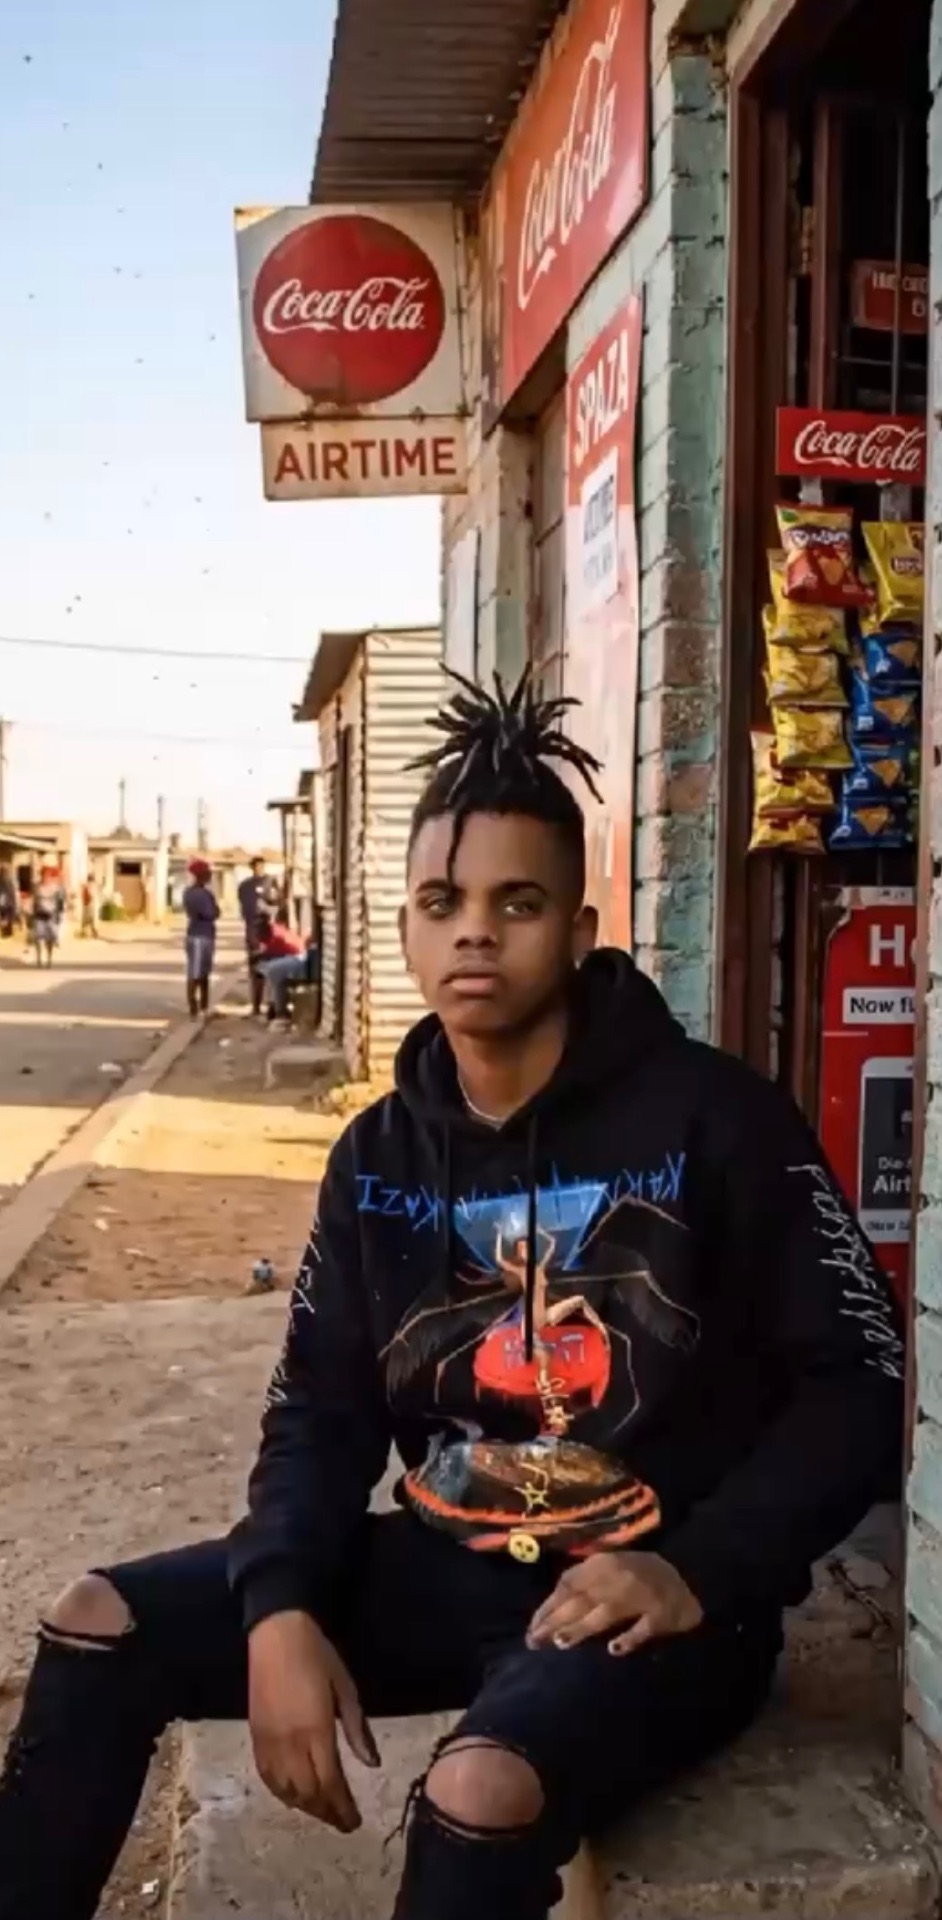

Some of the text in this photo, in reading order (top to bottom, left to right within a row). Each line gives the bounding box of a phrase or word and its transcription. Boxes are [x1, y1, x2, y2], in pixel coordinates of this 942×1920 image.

[262, 276, 431, 334] Coca-Cola
[574, 328, 629, 468] SPAZA
[274, 437, 457, 484] AIRTIME
[794, 419, 926, 471] Coca-Cola
[850, 997, 894, 1013] Now
[873, 1175, 911, 1194] Airt
